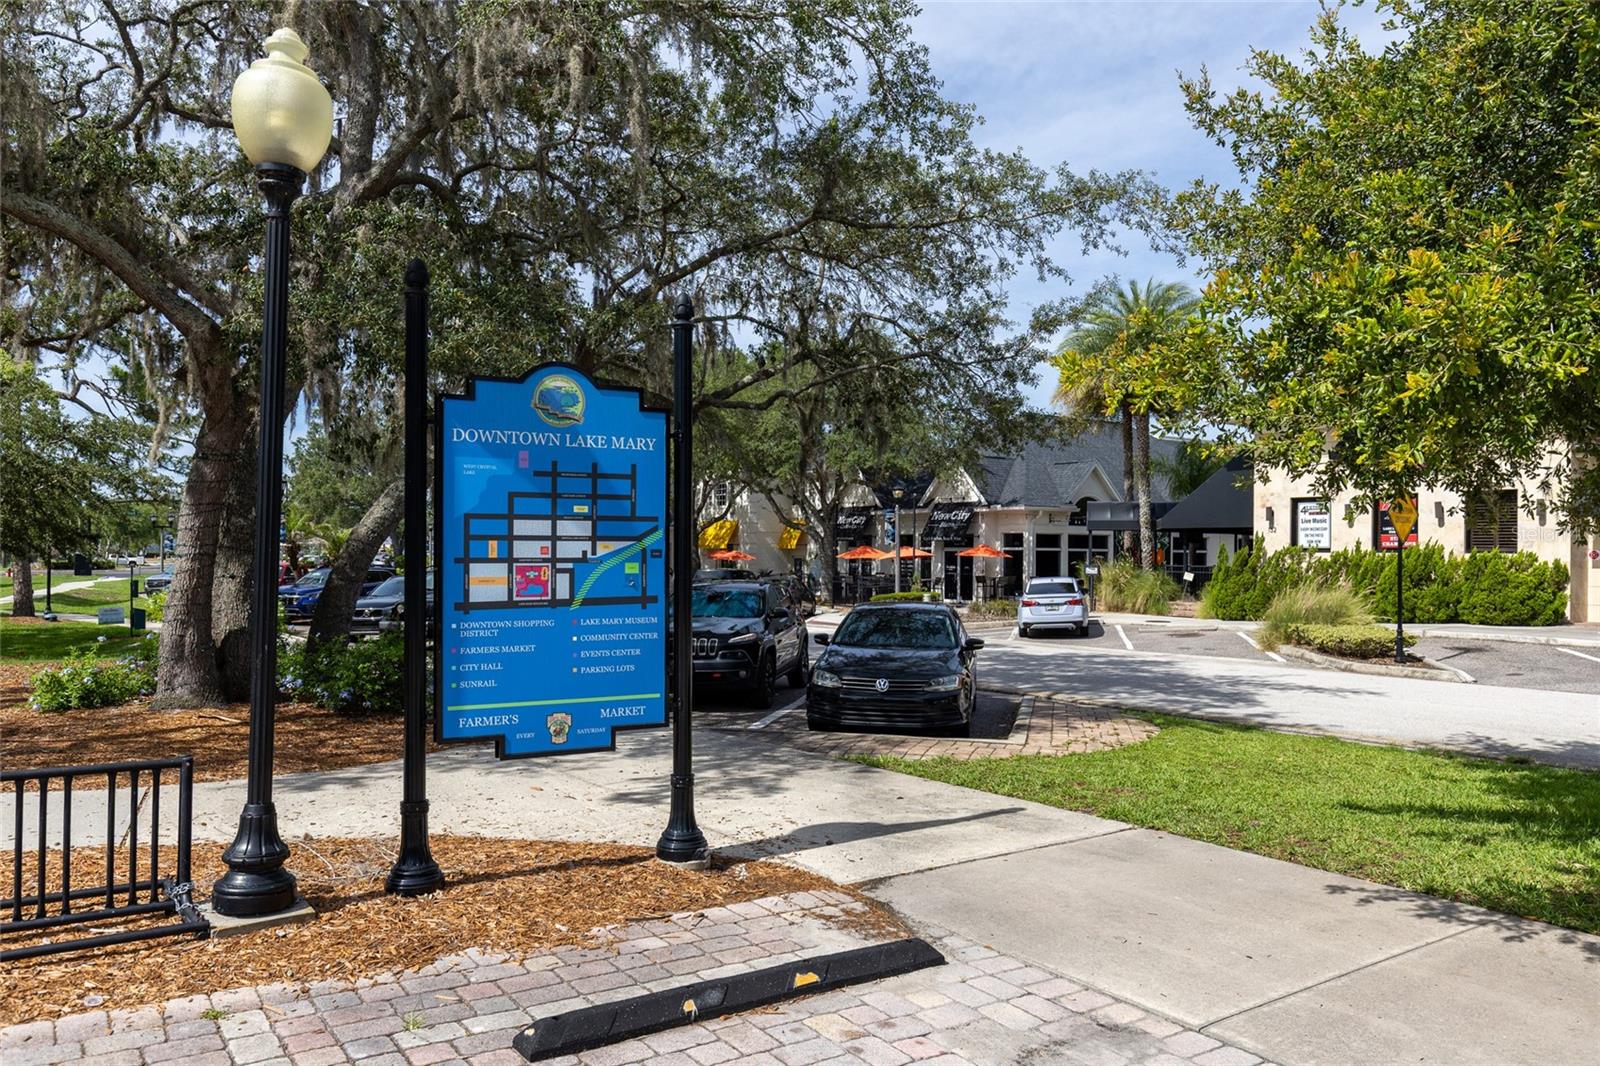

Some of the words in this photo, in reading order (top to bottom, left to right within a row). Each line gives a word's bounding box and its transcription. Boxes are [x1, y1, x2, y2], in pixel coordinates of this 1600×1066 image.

[452, 428, 561, 447] DOWNTOWN
[565, 433, 608, 449] LAKE
[611, 436, 657, 452] MARY
[460, 619, 513, 630] DOWNTOWN
[513, 619, 556, 629] SHOPPING
[580, 618, 601, 626] LAKE
[601, 617, 625, 626] MARY
[624, 616, 659, 625] MUSEUM
[460, 628, 499, 638] DISTRICT
[580, 633, 629, 642] COMMUNITY
[628, 632, 659, 641] CENTER
[460, 645, 500, 655] FARMERS
[500, 644, 537, 653] MARKET
[580, 649, 611, 658] EVENTS
[611, 648, 641, 657] CENTER
[459, 663, 480, 672] CITY
[480, 662, 504, 671] HALL
[580, 665, 615, 674] PARKING
[615, 664, 636, 673] LOTS
[459, 679, 498, 689] SUNRAIL
[458, 714, 520, 728] FARMER'S
[600, 705, 647, 718] MARKET
[515, 732, 536, 740] EVERY
[576, 726, 607, 735] SATURDAY
